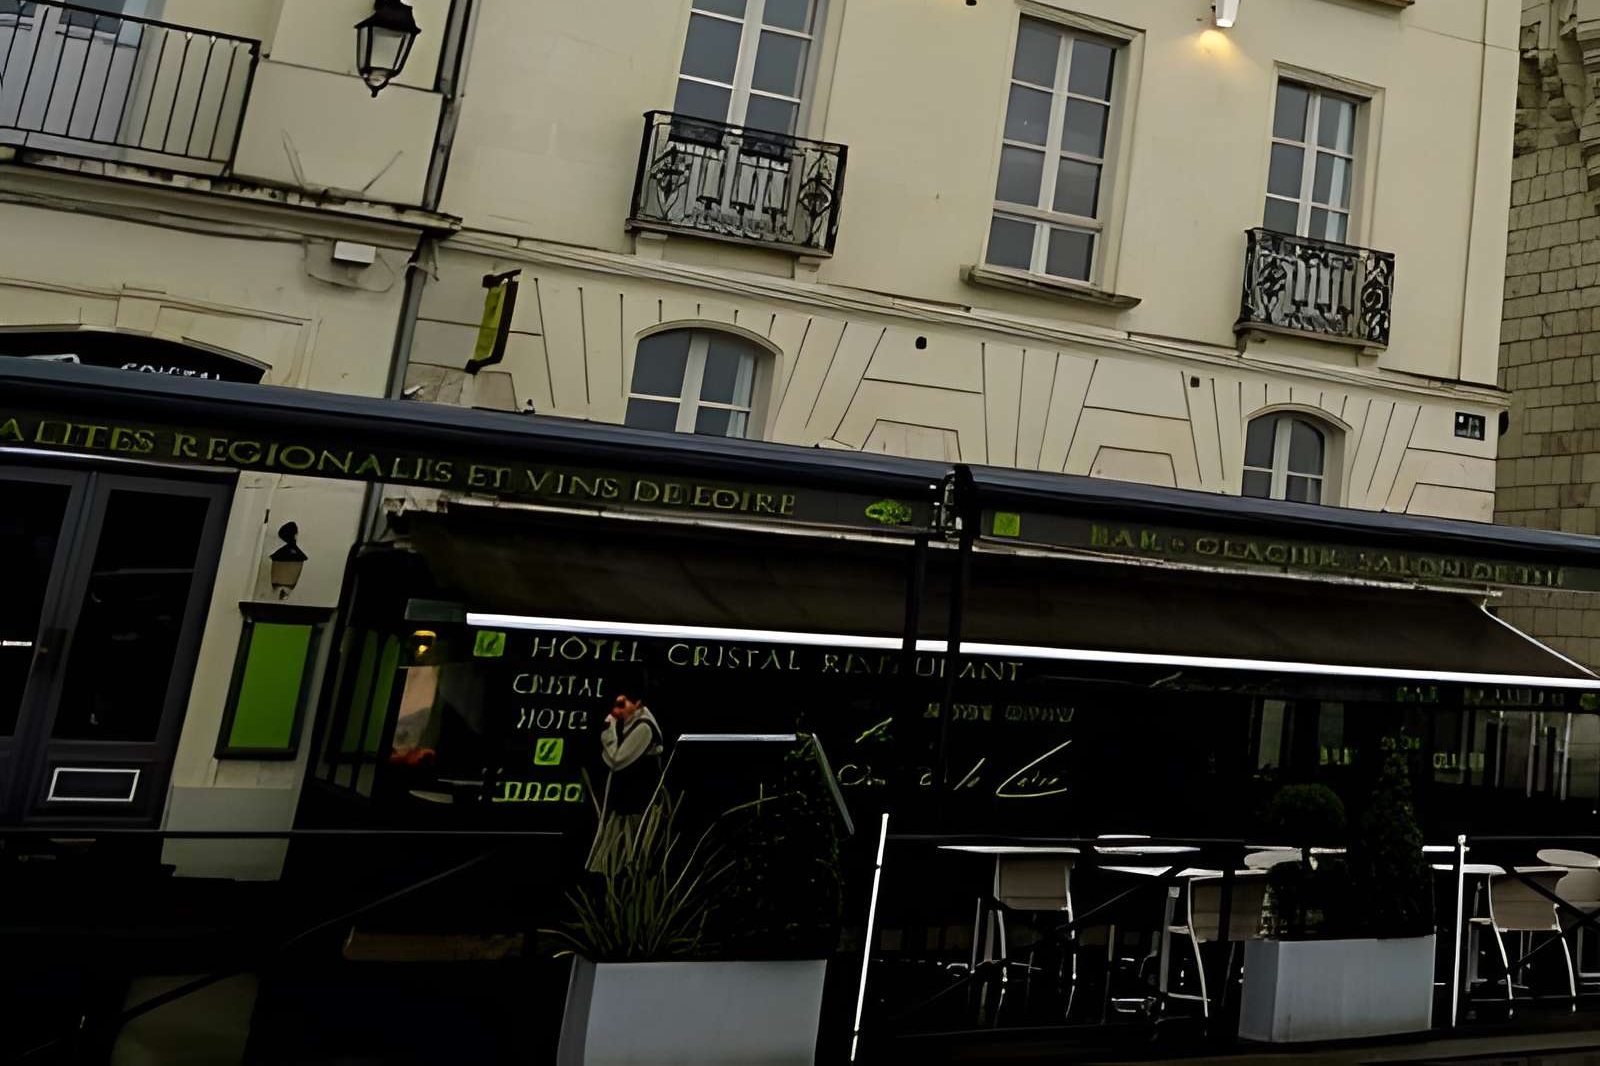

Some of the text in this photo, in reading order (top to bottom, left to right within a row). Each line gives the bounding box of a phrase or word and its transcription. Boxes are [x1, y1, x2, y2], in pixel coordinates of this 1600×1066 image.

[467, 464, 513, 488] ET
[526, 469, 620, 499] VINS
[688, 485, 796, 515] LOIRE
[530, 635, 643, 664] HOTEL
[667, 643, 800, 671] CRISTAL
